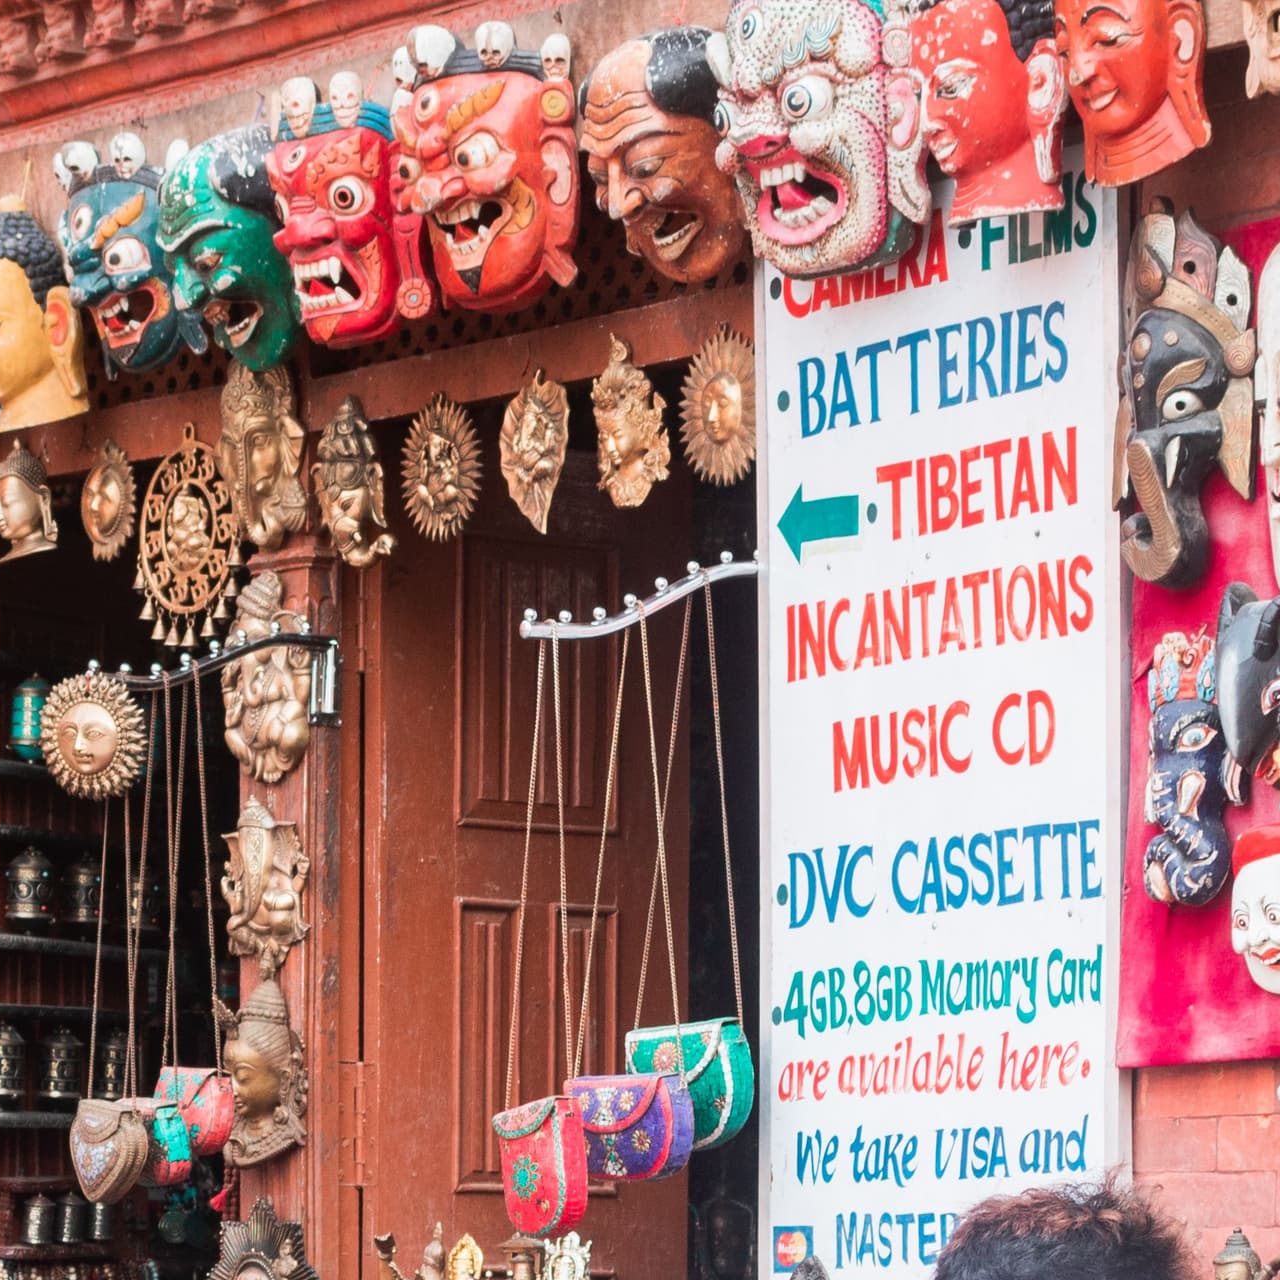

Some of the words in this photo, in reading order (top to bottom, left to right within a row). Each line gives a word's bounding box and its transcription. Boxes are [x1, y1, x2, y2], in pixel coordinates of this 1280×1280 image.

[798, 300, 1069, 438] BATTERIES
[876, 426, 1078, 541] TIBETAN
[786, 555, 1094, 683] INCANTATIONS
[832, 700, 973, 793] MUSIC
[992, 689, 1056, 766] CD
[787, 844, 877, 929] DVC
[891, 819, 1102, 915] CASSETTE
[918, 955, 1039, 1024] Memory
[1047, 944, 1103, 1008] Card
[777, 1055, 831, 1103] are
[837, 1032, 985, 1098] available
[998, 1031, 1092, 1091] here.
[849, 1124, 918, 1188] take
[935, 1126, 1011, 1181] VISA
[1019, 1113, 1089, 1174] and
